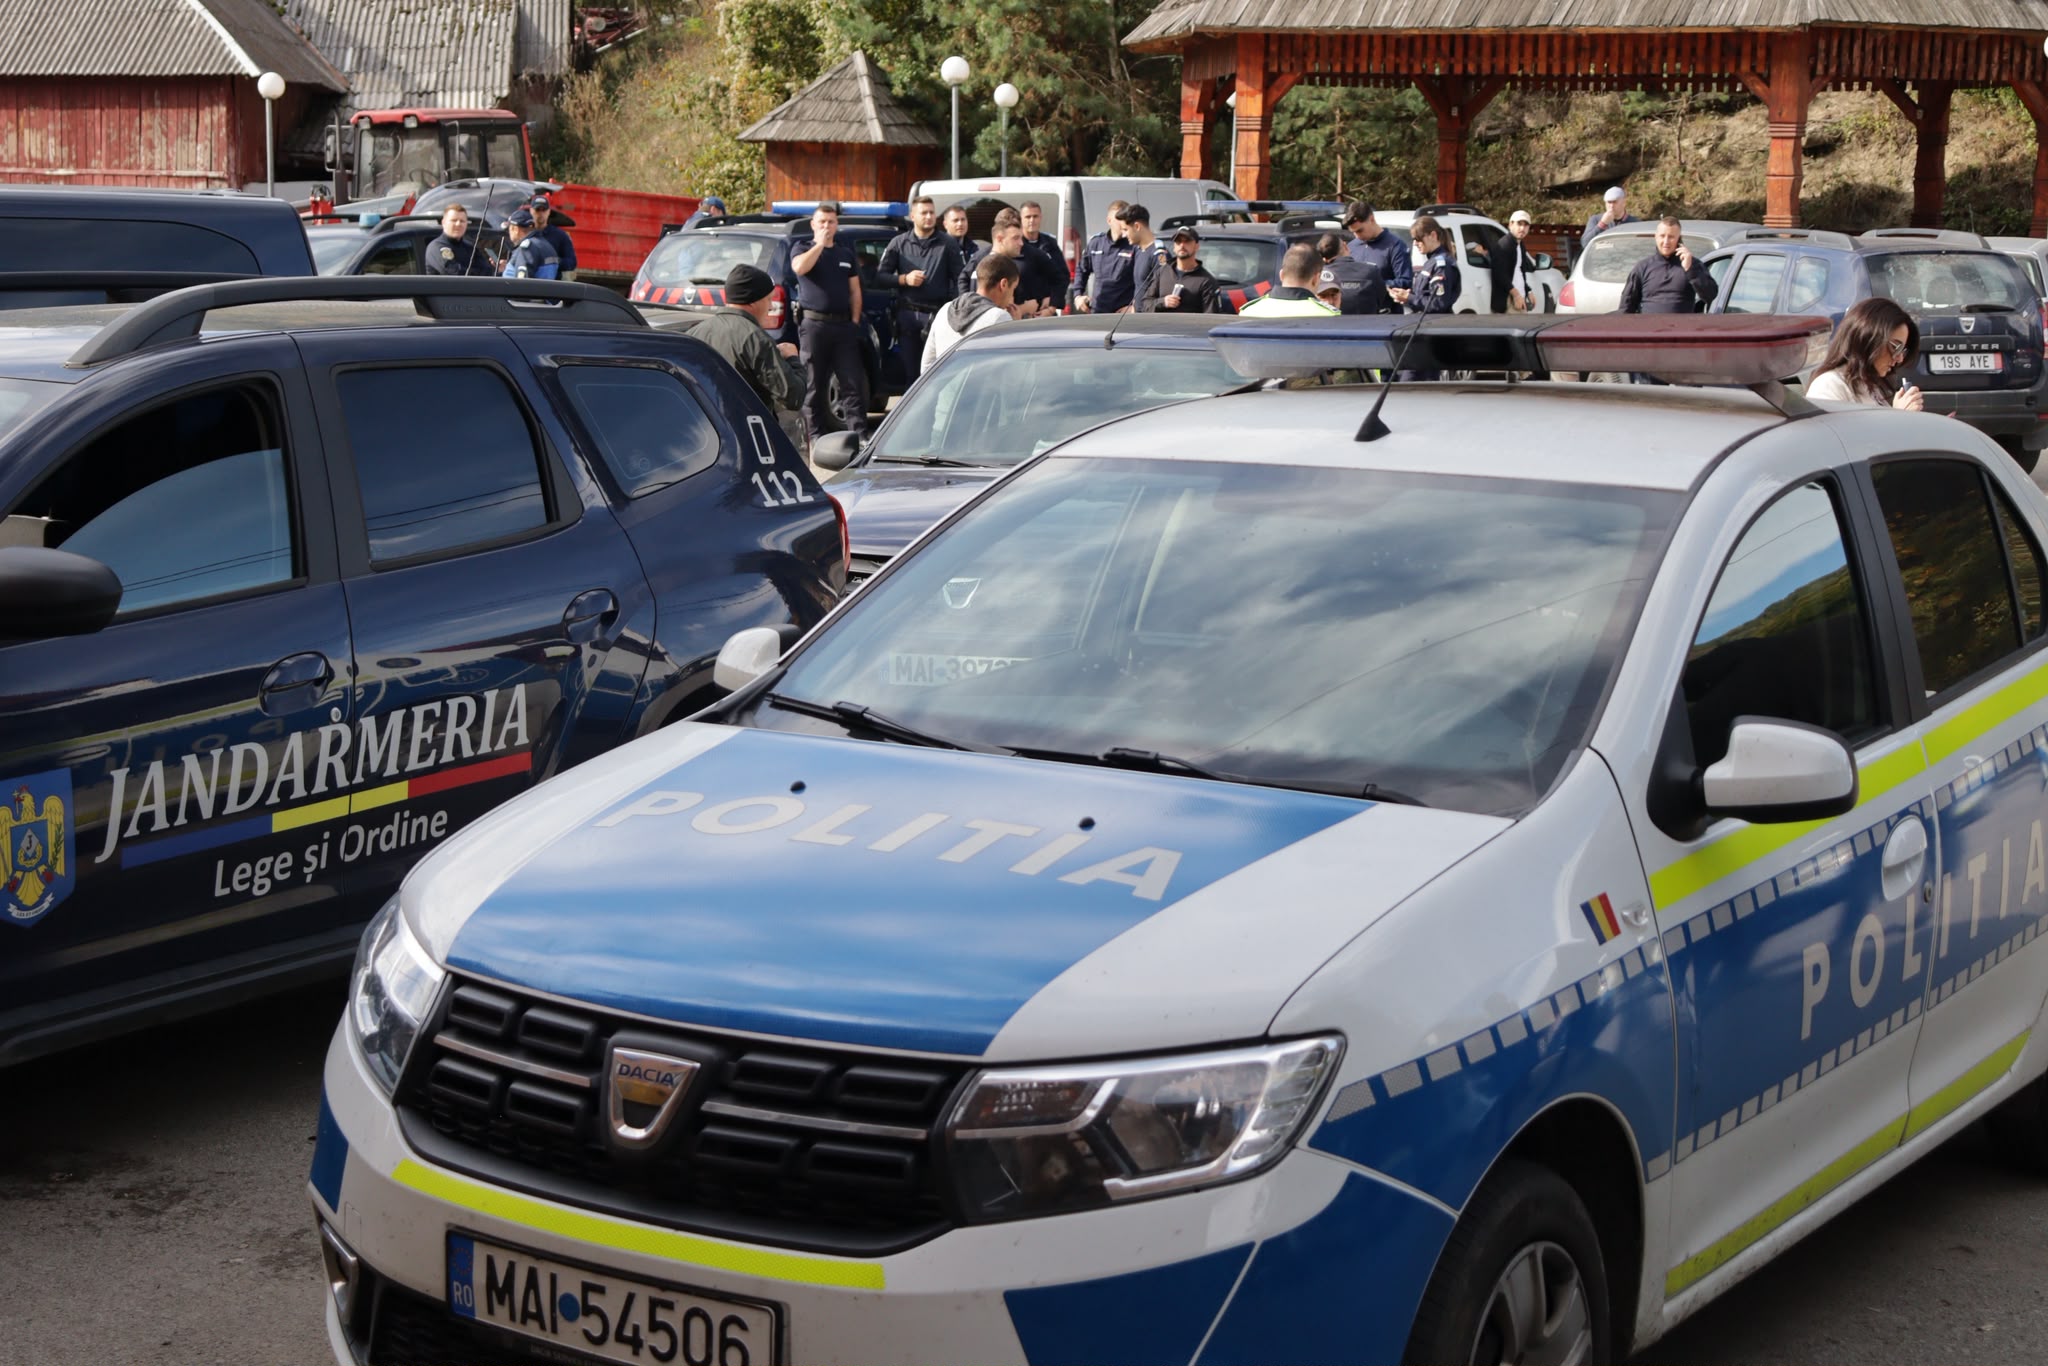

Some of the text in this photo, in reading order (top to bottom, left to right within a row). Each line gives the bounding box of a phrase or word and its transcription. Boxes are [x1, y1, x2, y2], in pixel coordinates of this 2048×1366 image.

[1934, 343, 2000, 351] DUSTER
[1969, 355, 1990, 369] AYE
[751, 470, 814, 507] 112
[896, 656, 934, 682] MAI
[95, 683, 530, 864] JANDARMERIA
[214, 809, 448, 897] Lege și Ordine
[593, 791, 1183, 901] POLITIA
[1800, 818, 2045, 1041] POLITIA
[618, 1063, 675, 1087] DACIA
[453, 1281, 472, 1307] RO
[485, 1253, 749, 1366] MAI 54506
